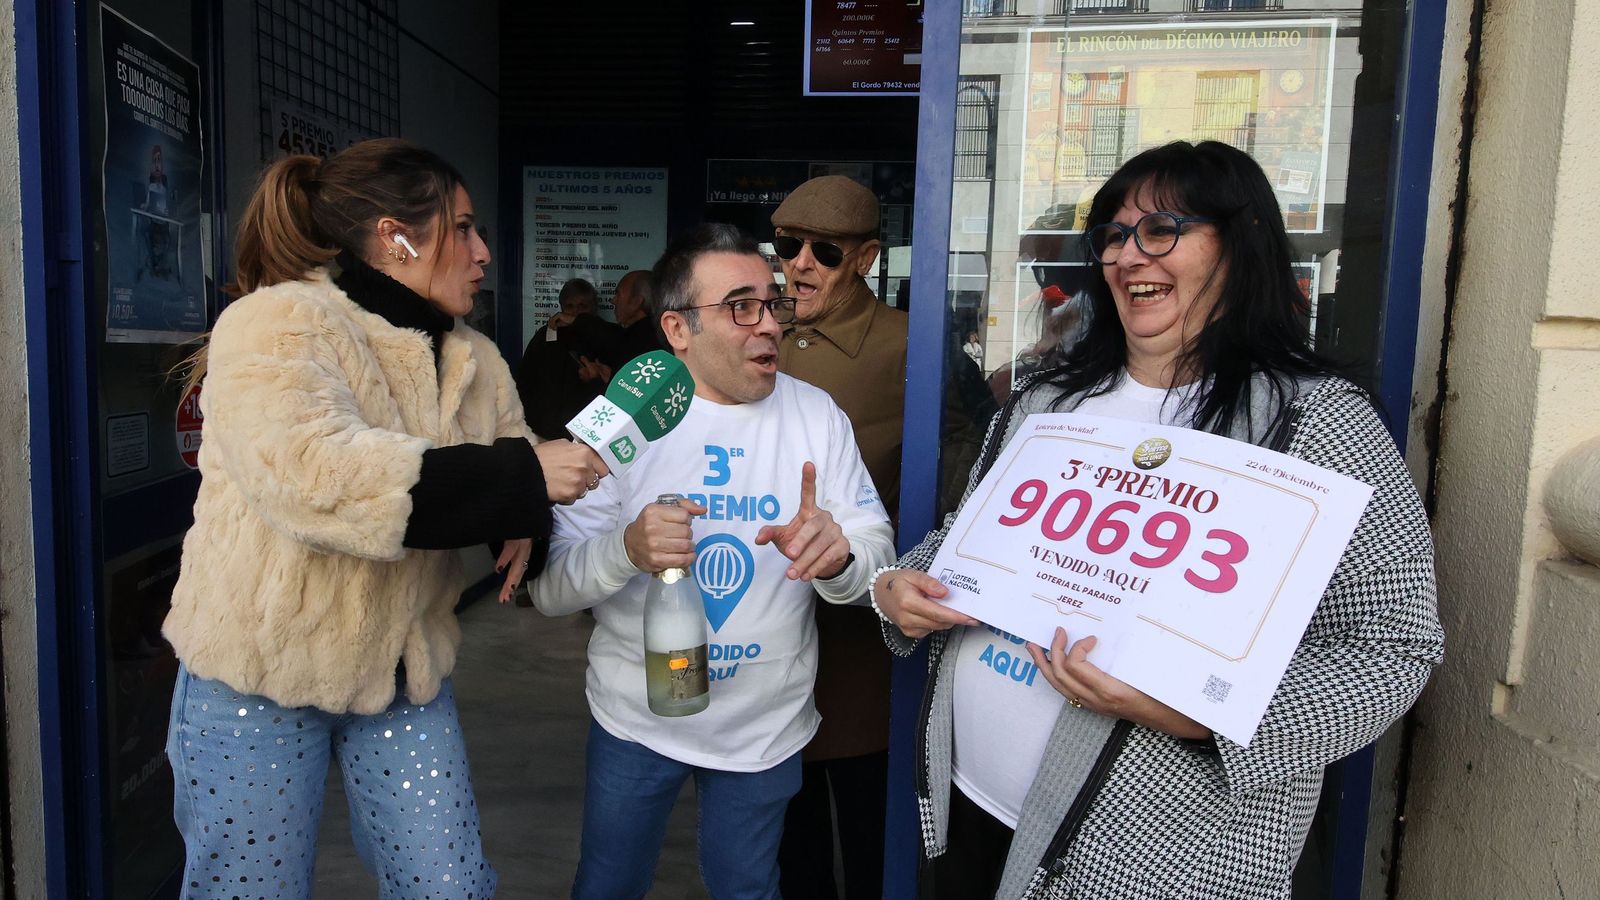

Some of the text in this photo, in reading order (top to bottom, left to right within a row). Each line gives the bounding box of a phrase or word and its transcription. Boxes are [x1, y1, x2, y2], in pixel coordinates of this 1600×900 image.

[1056, 29, 1301, 53] EL RINCÓN DEL DÉCIMO VIAJERO
[117, 60, 128, 82] ES
[129, 66, 145, 91] UNA
[291, 115, 335, 146] PREMIO
[527, 170, 665, 181] NUESTROS PREMIOS
[602, 186, 612, 195] 5
[614, 184, 653, 195] AÑOS
[1094, 466, 1219, 513] PREMIO
[1245, 459, 1330, 494] 22 de Diciembre
[687, 493, 781, 522] REMIO
[998, 478, 1249, 594] 90693
[1030, 545, 1152, 595] VENDIDO AQUÍ
[949, 579, 982, 596] NACIONAL
[1071, 583, 1082, 596] EL
[1082, 587, 1122, 605] PARAISO
[1056, 594, 1083, 609] JEREZ
[708, 643, 761, 661] DIDO
